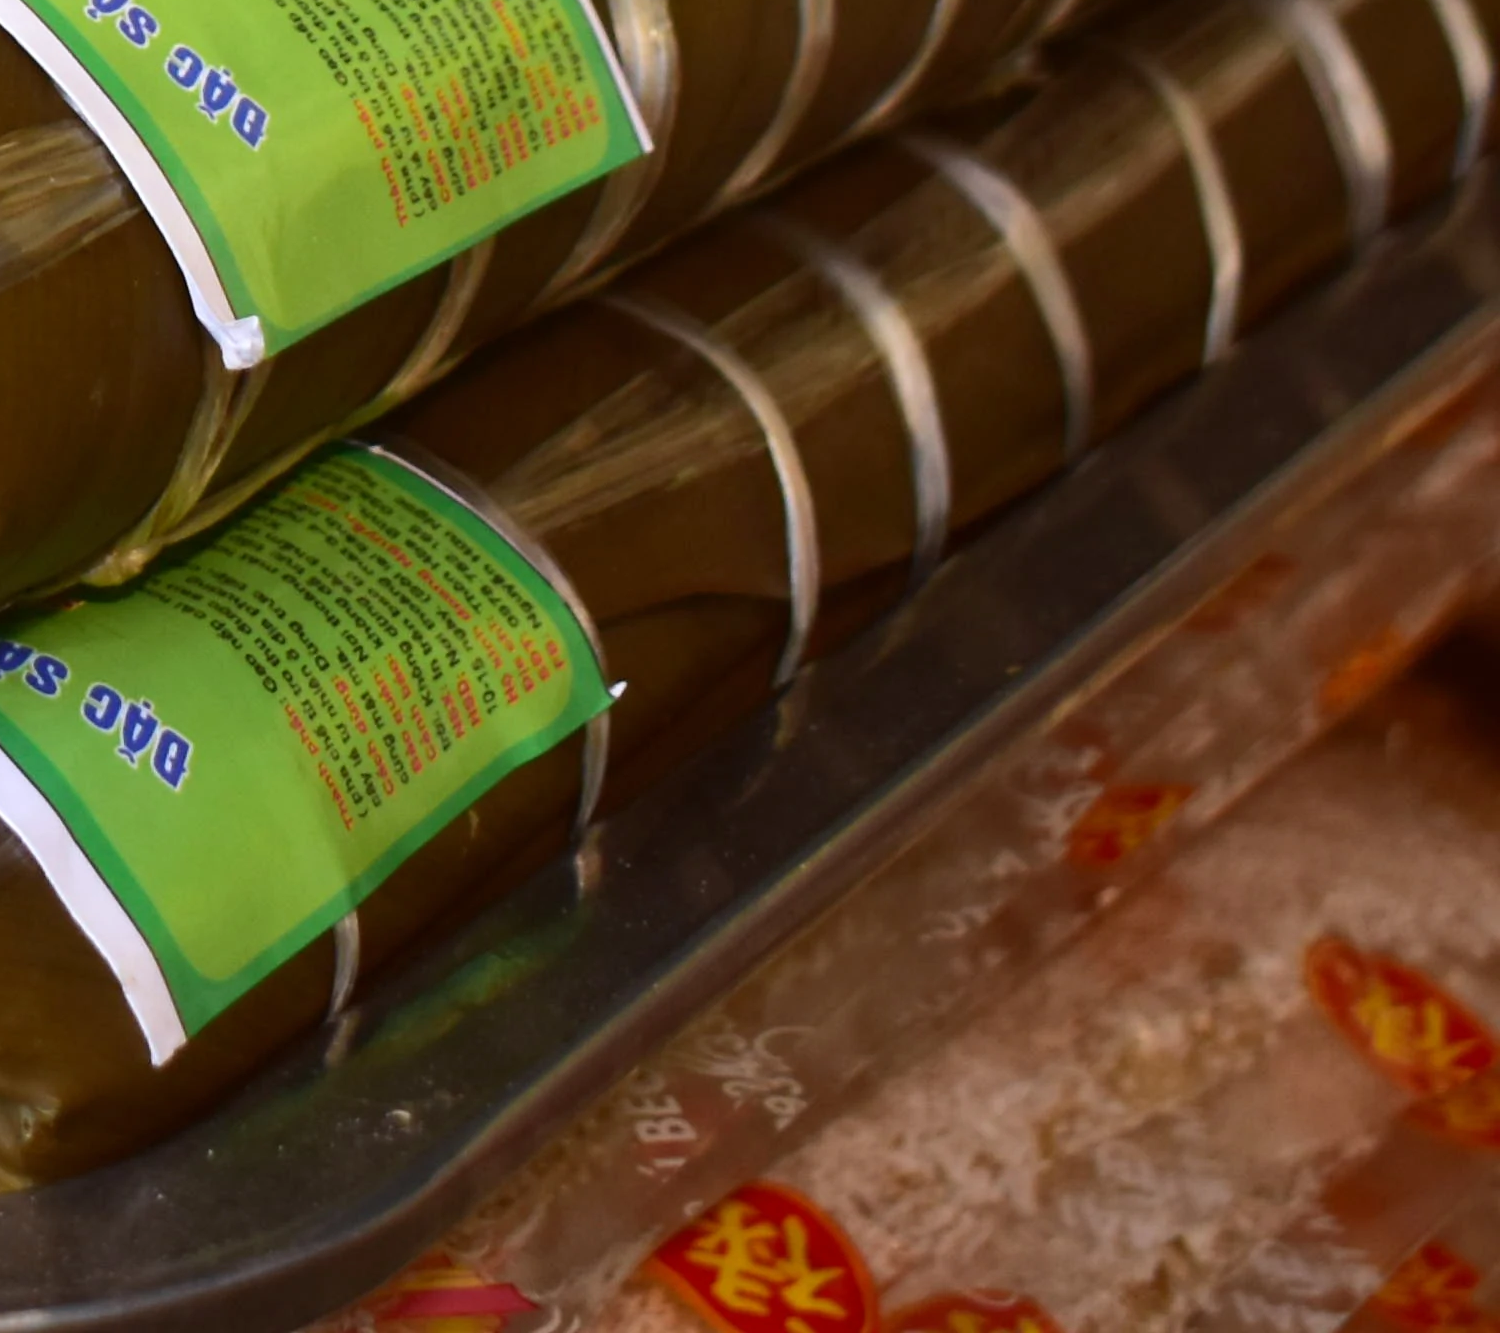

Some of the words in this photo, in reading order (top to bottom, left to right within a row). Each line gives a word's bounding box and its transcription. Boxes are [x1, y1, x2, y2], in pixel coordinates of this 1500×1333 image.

[317, 47, 349, 87] Gạo
[327, 34, 353, 65] thu
[360, 25, 398, 77] Dùng
[164, 45, 268, 148] ĐẶC
[460, 66, 489, 132] Không
[381, 122, 404, 161] chế
[422, 102, 445, 141] mật
[426, 148, 451, 203] Cách
[441, 145, 465, 196] cùng
[466, 125, 490, 182] Cảnh
[380, 156, 408, 227] Thành
[399, 164, 421, 205] pha
[279, 571, 340, 627] thoáng
[442, 569, 481, 614] Thôn
[482, 562, 541, 629] Nguyễn
[208, 618, 243, 650] nếp
[259, 617, 287, 646] địa
[333, 595, 383, 649] không
[354, 594, 398, 637] dùng
[401, 616, 433, 656] trên
[253, 636, 281, 668] thu
[287, 619, 330, 672] Dùng
[335, 645, 361, 686] mía.
[340, 628, 369, 663] Nơi
[435, 632, 461, 668] Nơi
[243, 652, 278, 694] Gạo
[280, 668, 302, 697] tro
[299, 663, 337, 718] nhiên
[387, 652, 412, 701] báo:
[398, 639, 434, 707] Không
[429, 657, 444, 682] In
[470, 656, 497, 715] 10-15
[499, 672, 519, 704] Hộ
[514, 656, 535, 693] Địa
[331, 674, 369, 735] dùng:
[359, 690, 385, 730] mật
[456, 672, 482, 727] HSD:
[80, 681, 192, 788] ĐẶC
[278, 696, 320, 756] phần:
[312, 723, 341, 762] chế
[409, 703, 437, 761] Cảnh
[347, 746, 363, 768] lá
[366, 740, 395, 796] Cách
[381, 732, 410, 785] cùng
[400, 729, 423, 773] Bảo
[317, 761, 353, 831] Thành
[338, 764, 364, 805] pha
[359, 771, 382, 808] cây
